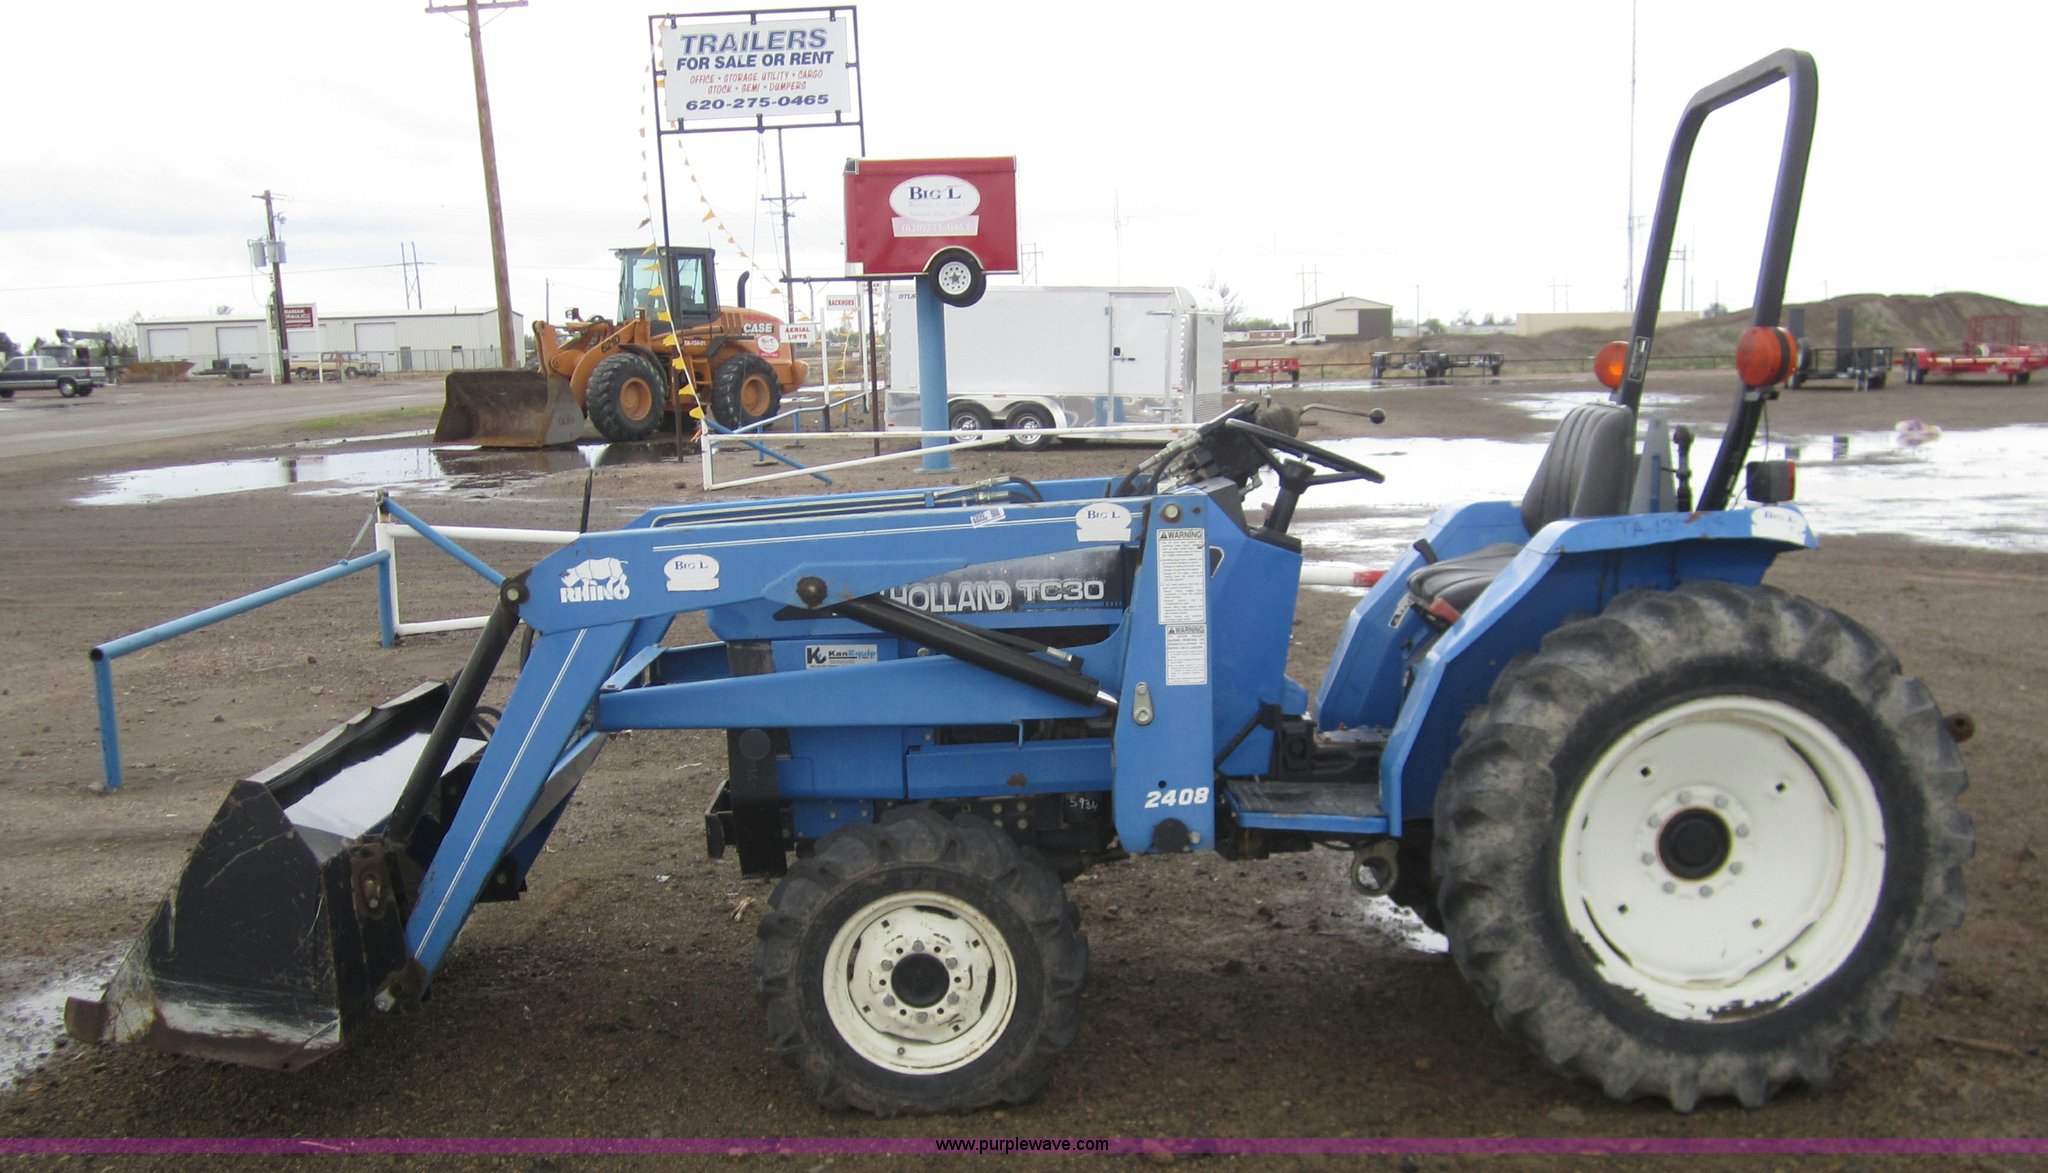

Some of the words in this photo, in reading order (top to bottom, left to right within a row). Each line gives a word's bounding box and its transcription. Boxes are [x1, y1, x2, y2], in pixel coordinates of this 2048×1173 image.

[680, 28, 828, 55] TRAILERS
[676, 56, 710, 71] FOR
[714, 54, 757, 69] SALE
[762, 53, 785, 66] OR
[789, 51, 834, 66] RENT
[690, 74, 715, 84] OFFICE
[723, 72, 758, 83] STORAGE
[761, 71, 789, 81] UTILITY
[797, 69, 823, 79] CARGO
[707, 85, 732, 95] STOCK
[685, 94, 829, 111] 620-275-0465
[743, 322, 773, 333] CASE
[889, 580, 1011, 612] HOLLAND
[1016, 578, 1105, 601] TC30
[1176, 625, 1204, 633] WARNING
[828, 649, 876, 659] KanEquip
[1144, 787, 1209, 808] 2408
